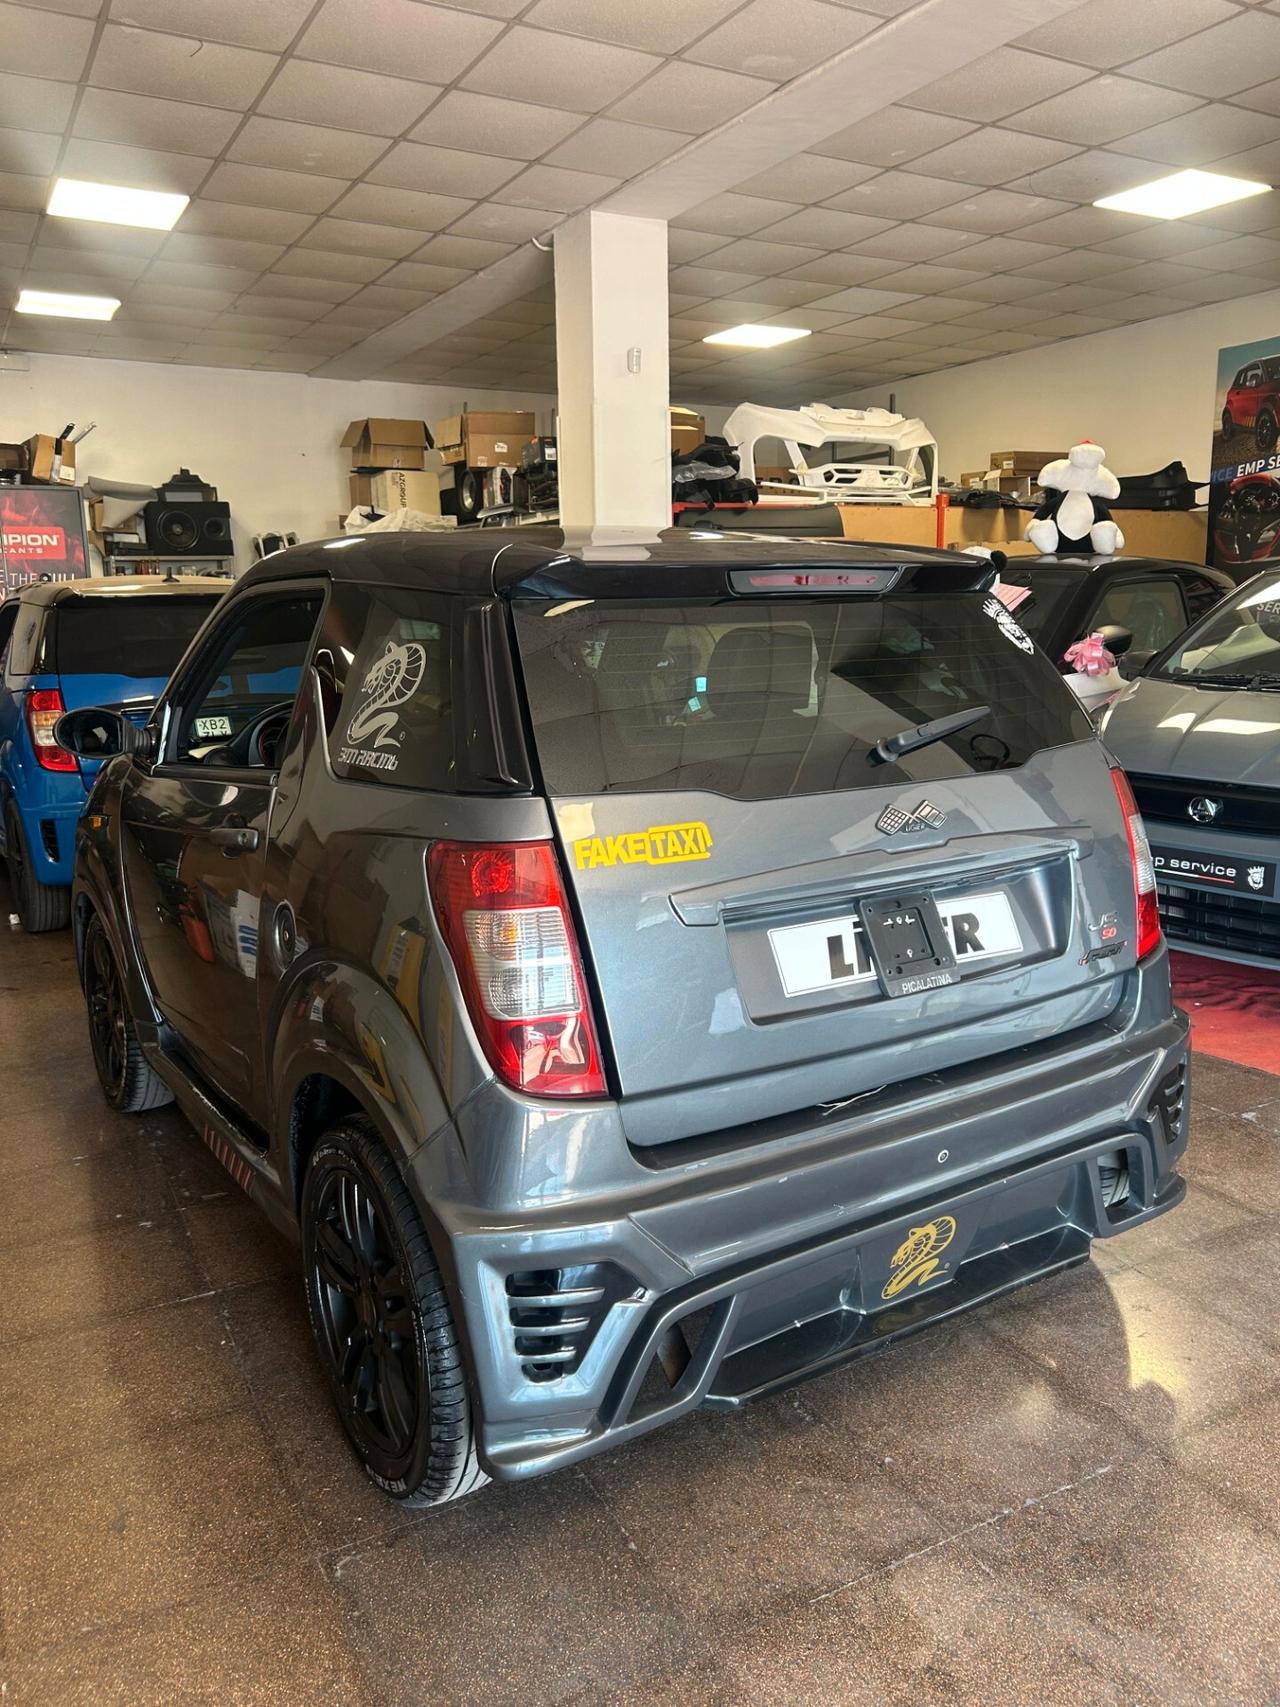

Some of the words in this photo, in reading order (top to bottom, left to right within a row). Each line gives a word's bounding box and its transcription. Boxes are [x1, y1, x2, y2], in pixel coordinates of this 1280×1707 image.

[1236, 459, 1266, 477] EMP
[1170, 859, 1237, 877] service
[902, 973, 953, 994] PICALATINA
